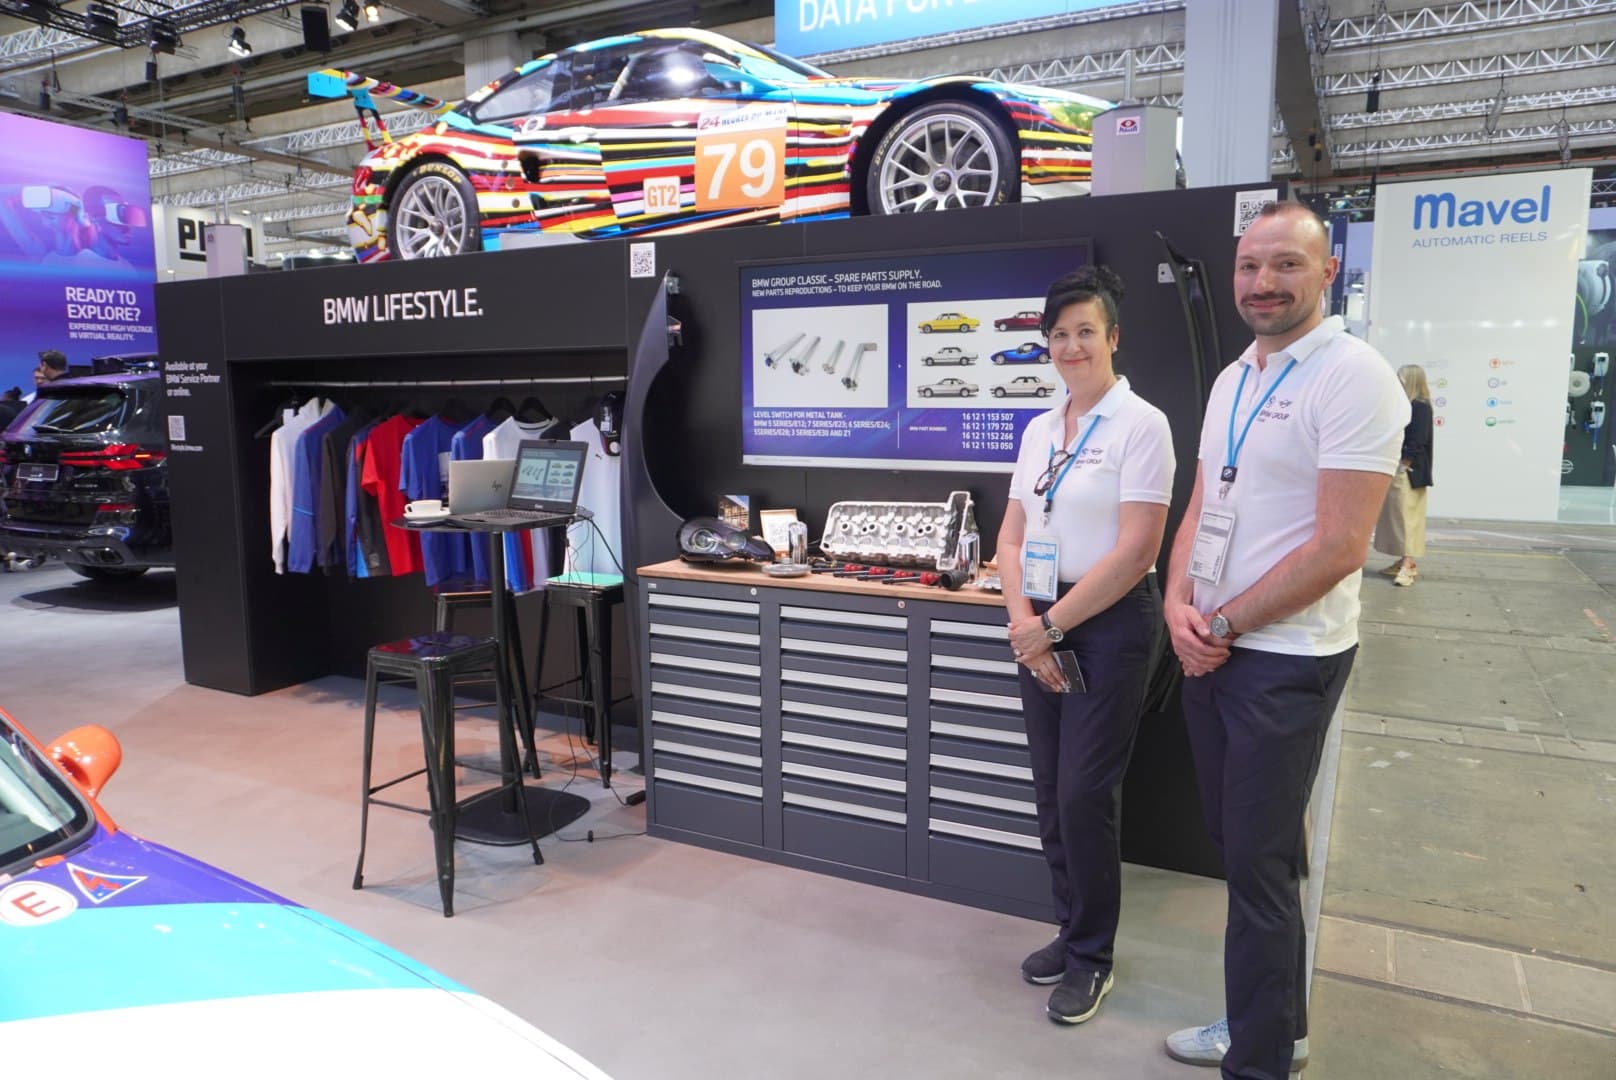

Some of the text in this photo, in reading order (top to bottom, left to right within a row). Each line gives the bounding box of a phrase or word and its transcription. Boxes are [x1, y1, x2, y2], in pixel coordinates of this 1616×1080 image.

[419, 164, 461, 183] DUNLOP
[703, 139, 776, 199] 79
[647, 184, 677, 207] GT2
[1413, 184, 1551, 230] mavel
[1412, 231, 1547, 248] AUTOMATIC REELS
[752, 278, 769, 288] BMW
[771, 276, 796, 287] GROUP
[797, 274, 827, 285] CLASSIC
[834, 272, 860, 283] SPARE
[861, 271, 887, 282] PARTS
[888, 268, 923, 280] SUPPLY.
[752, 289, 765, 297] NEW
[766, 288, 784, 296] PARTS
[785, 285, 833, 296] REPRODUCTIONS
[838, 285, 847, 293] TO
[847, 284, 862, 293] KEEP
[863, 283, 880, 292] YOUR
[881, 282, 897, 291] BMW
[897, 281, 907, 290] ON
[908, 280, 921, 289] THE
[922, 279, 943, 288] ROAD.
[65, 286, 136, 306] READY TO
[323, 287, 484, 325] BMW LIFESTYLE.
[67, 303, 141, 322] EXPLORE?
[68, 322, 153, 334] EXPERIENCE HIGH VOLTAGE
[69, 331, 78, 339] IN
[78, 332, 106, 341] VIRTUAL
[165, 361, 208, 372] Available at your
[166, 373, 221, 385] BMW Service Partner
[166, 389, 173, 397] or
[754, 411, 771, 419] LEVEL
[772, 411, 793, 419] SWITCH
[793, 411, 805, 419] FOR
[806, 411, 826, 419] METAL
[826, 411, 843, 419] TANK
[962, 413, 971, 421] 16
[972, 413, 980, 421] 12
[987, 413, 999, 421] 153
[1000, 413, 1014, 421] 507
[754, 420, 768, 428] BMW
[962, 422, 971, 431] 16
[972, 422, 980, 431] 12
[987, 422, 999, 431] 179
[1000, 422, 1014, 431] 720
[829, 429, 843, 437] AND
[962, 432, 971, 440] 16
[972, 432, 980, 440] 12
[987, 432, 999, 440] 152
[1000, 432, 1014, 440] 266
[962, 441, 971, 450] 16
[972, 441, 980, 450] 12
[987, 441, 999, 450] 153
[1000, 441, 1014, 450] 050
[10, 890, 62, 918] E
